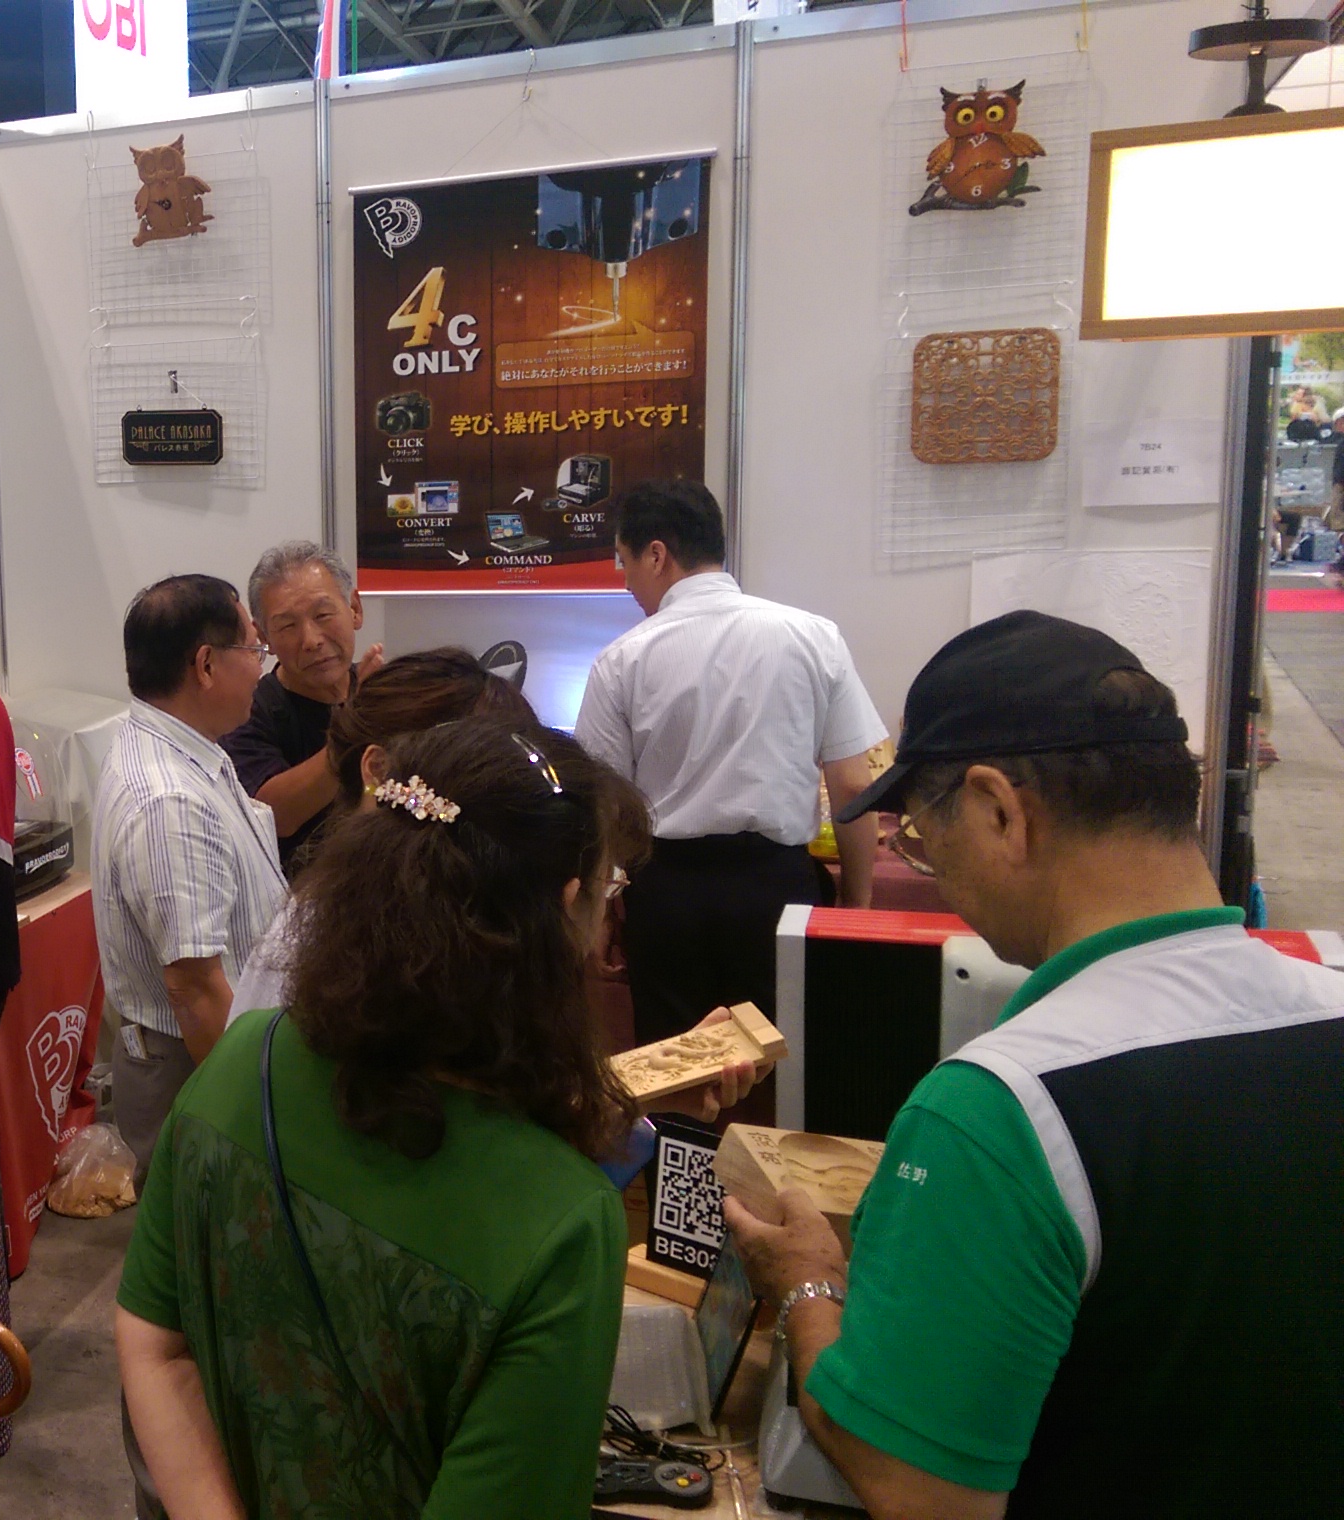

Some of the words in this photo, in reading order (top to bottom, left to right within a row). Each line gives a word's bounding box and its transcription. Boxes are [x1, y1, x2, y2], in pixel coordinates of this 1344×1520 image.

[972, 185, 982, 197] 6
[392, 348, 481, 376] ONLY
[131, 425, 166, 439] PALACE
[170, 425, 212, 439] AKASAKA
[388, 438, 424, 448] CLICK
[397, 518, 452, 528] CONVERT
[563, 513, 605, 523] CARVE
[485, 555, 552, 565] COMMAND
